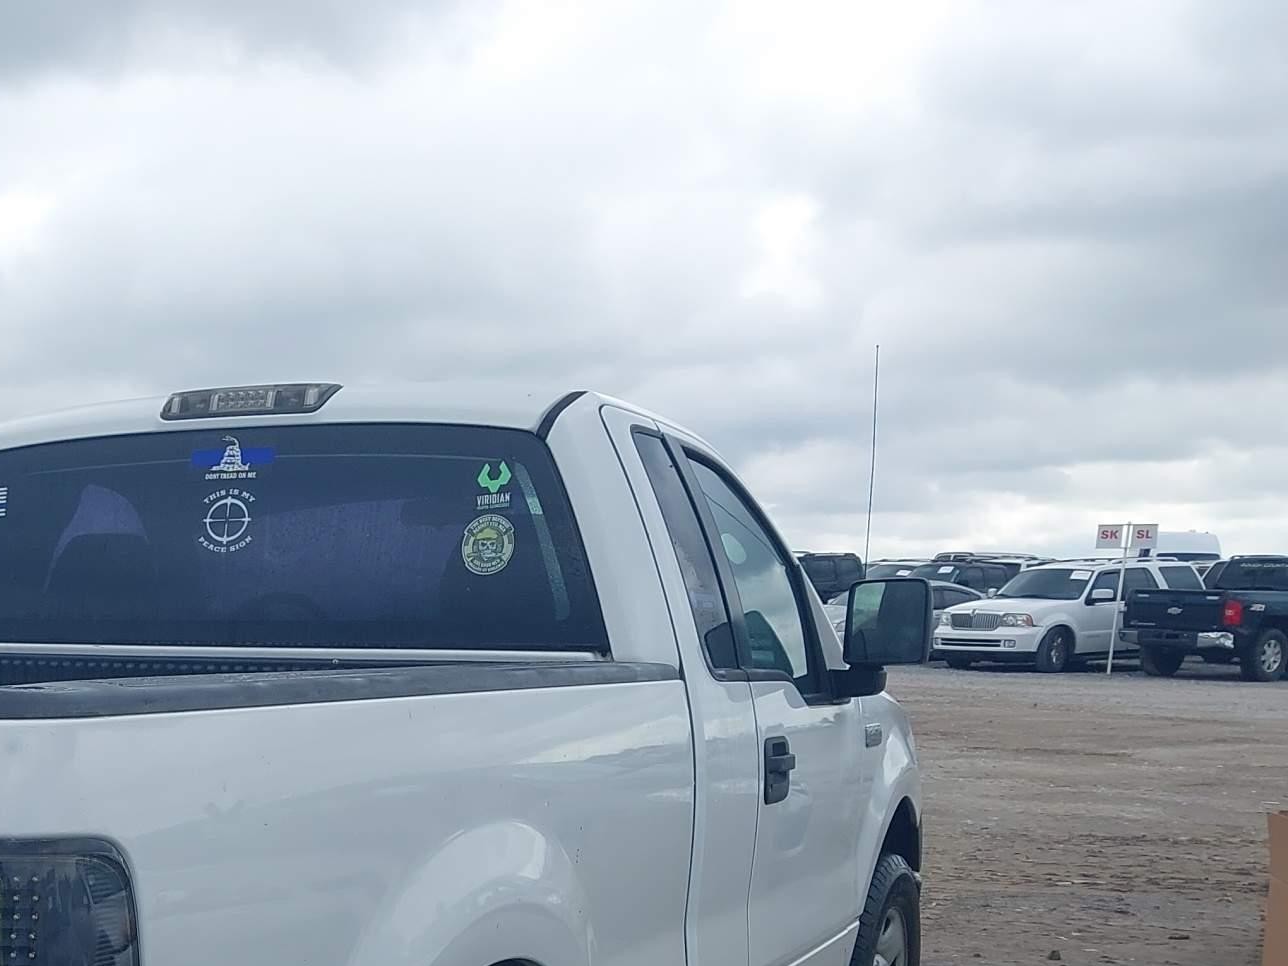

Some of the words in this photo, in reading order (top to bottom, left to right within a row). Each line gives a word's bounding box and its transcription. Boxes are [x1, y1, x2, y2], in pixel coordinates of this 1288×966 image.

[203, 489, 226, 504] THIS
[229, 488, 239, 496] IS
[241, 490, 256, 503] MY
[476, 492, 511, 506] VIRIDIAN
[1100, 529, 1119, 540] SK
[1136, 529, 1153, 539] SL
[198, 536, 227, 553] PEACE
[229, 535, 253, 552] SIGN
